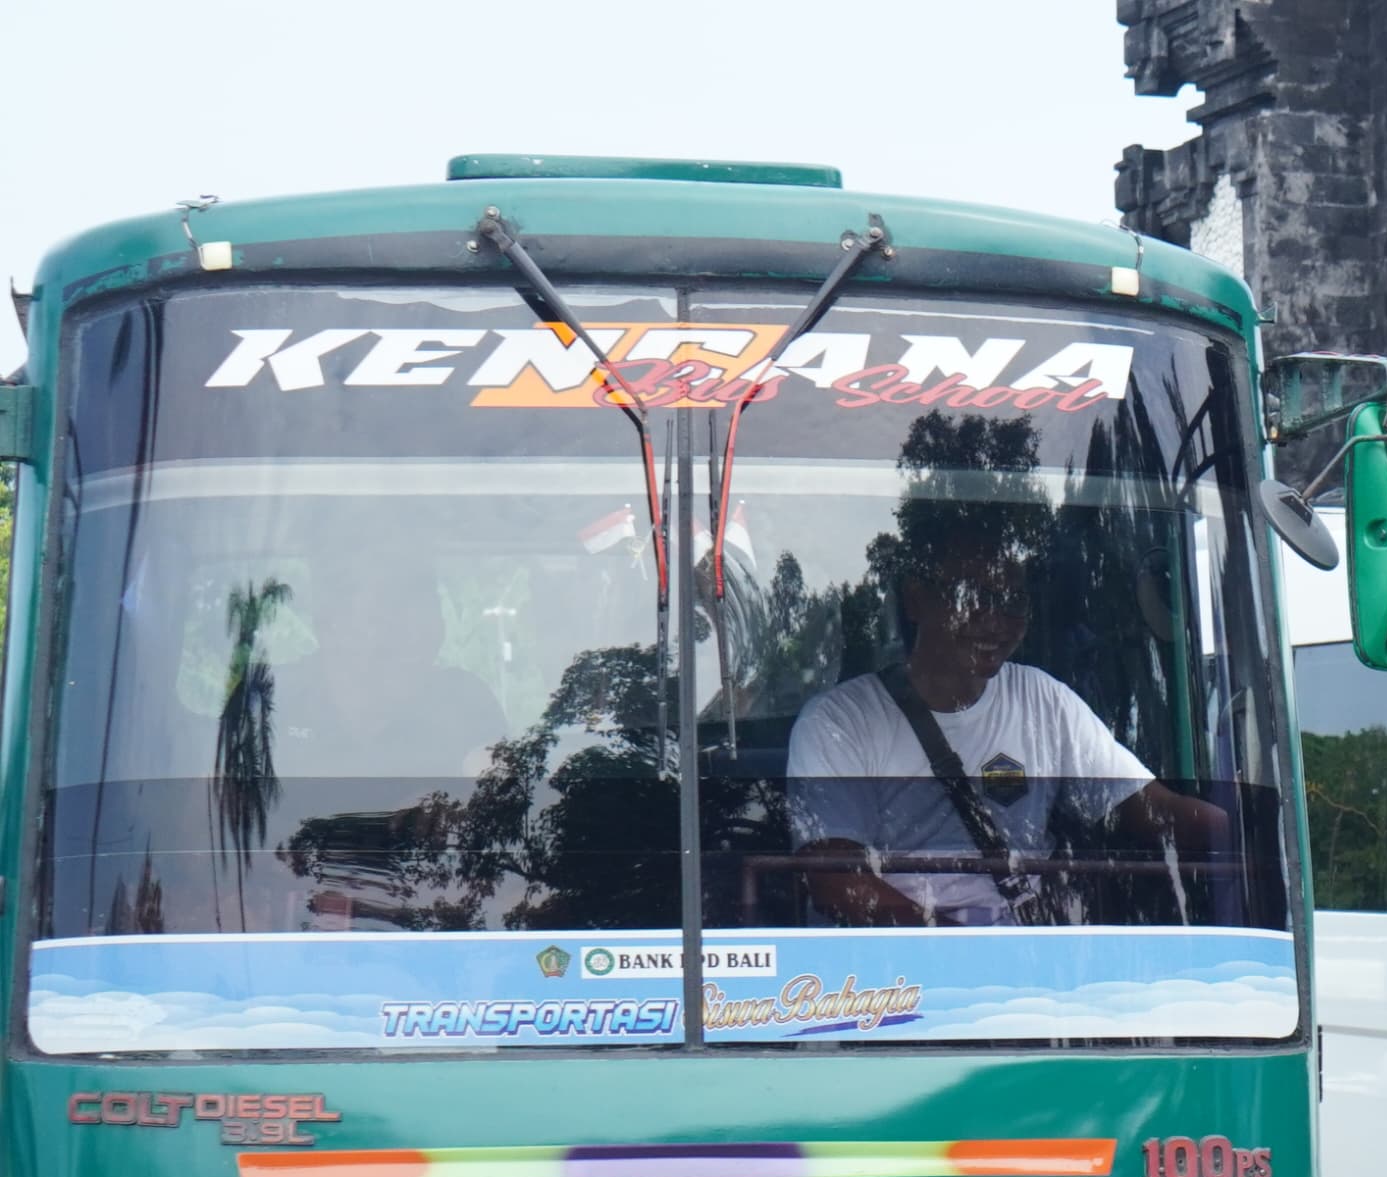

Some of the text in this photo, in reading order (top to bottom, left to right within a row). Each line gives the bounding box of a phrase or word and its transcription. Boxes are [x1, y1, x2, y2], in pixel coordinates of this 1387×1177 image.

[204, 328, 1134, 400] KENCANA
[592, 359, 1111, 412] Bus School
[618, 953, 674, 969] BANK
[727, 952, 772, 968] BALI
[381, 974, 922, 1038] TRANSPORTASI Siswa Bahagia
[68, 1091, 342, 1127] COLT DIESEL
